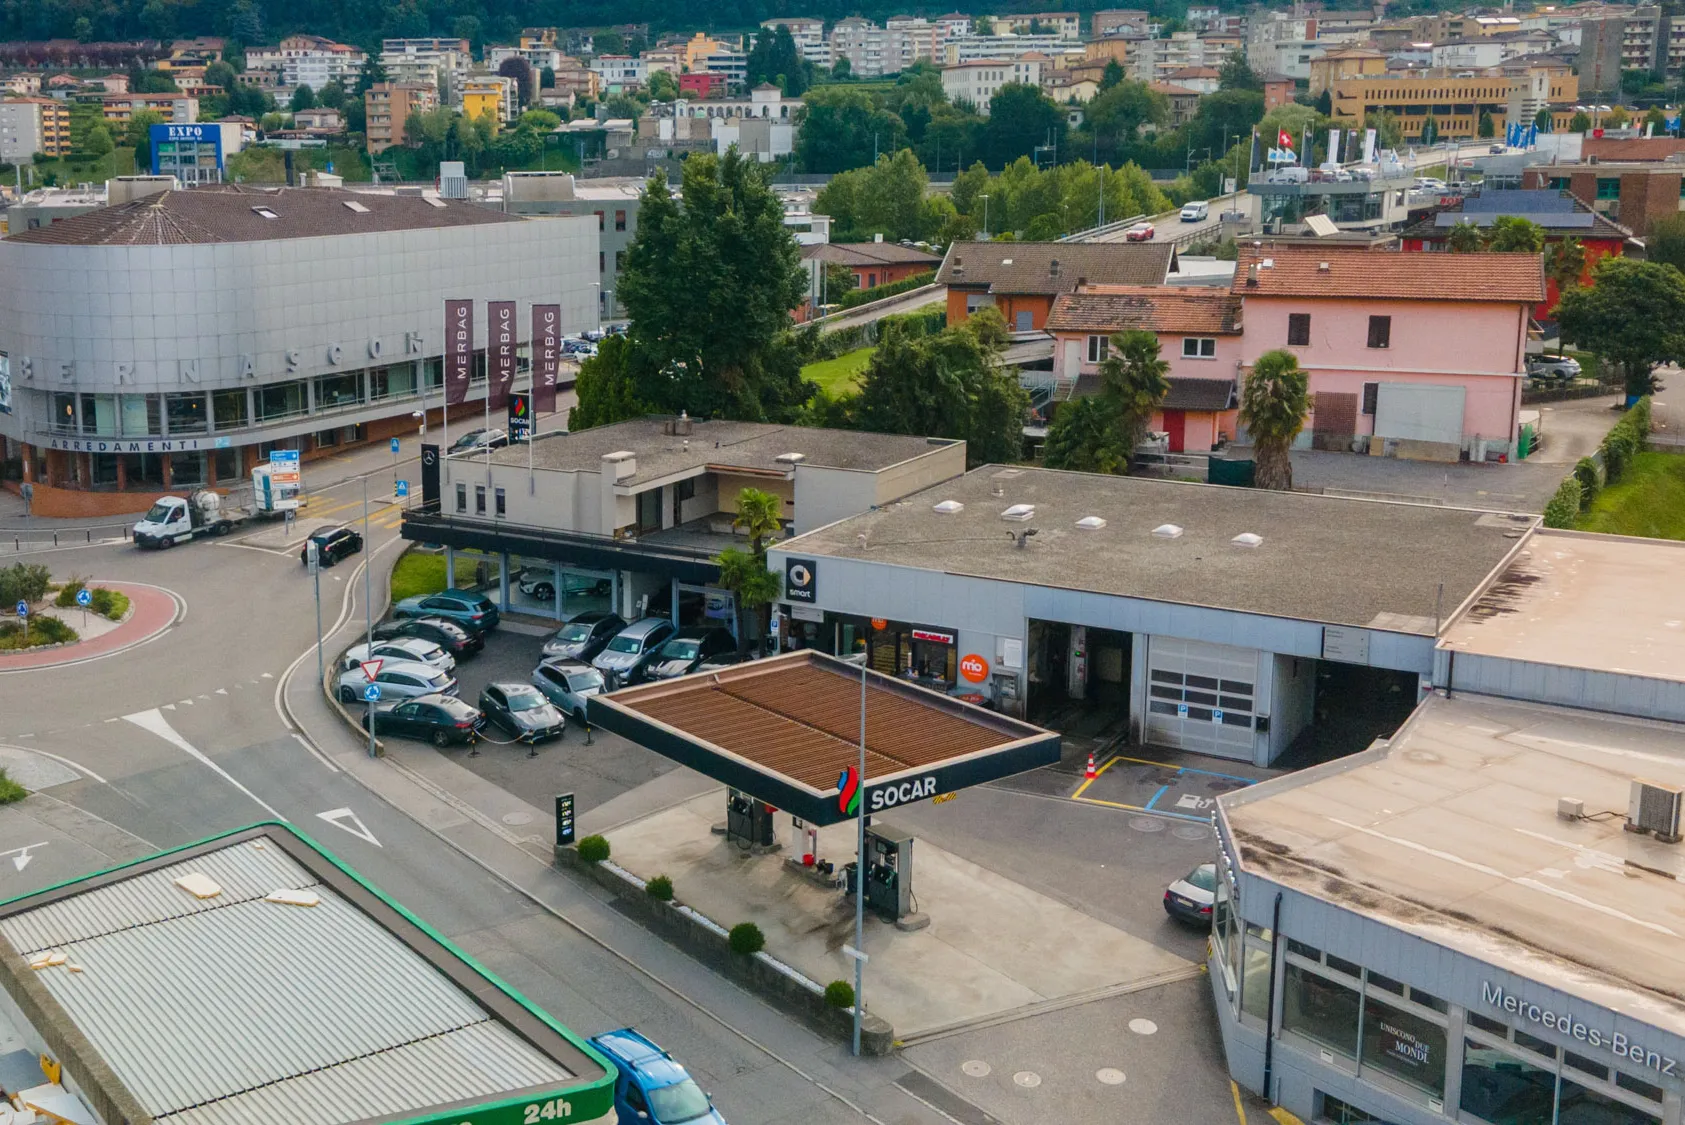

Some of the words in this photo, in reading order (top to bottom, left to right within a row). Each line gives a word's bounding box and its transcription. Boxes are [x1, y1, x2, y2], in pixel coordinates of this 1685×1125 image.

[168, 126, 203, 137] EXPO
[457, 306, 467, 379] MERBAG
[500, 308, 510, 382] MERBAG
[545, 312, 555, 385] MERBAG
[51, 439, 197, 452] ARREDAMENTI
[789, 589, 811, 598] smart
[962, 659, 982, 672] mio
[871, 777, 937, 810] SOCAR
[1380, 1022, 1416, 1043] UNISCONO
[1415, 1041, 1430, 1053] DUE
[1482, 981, 1677, 1077] Mercedes-Benz
[524, 1098, 571, 1125] 24h
